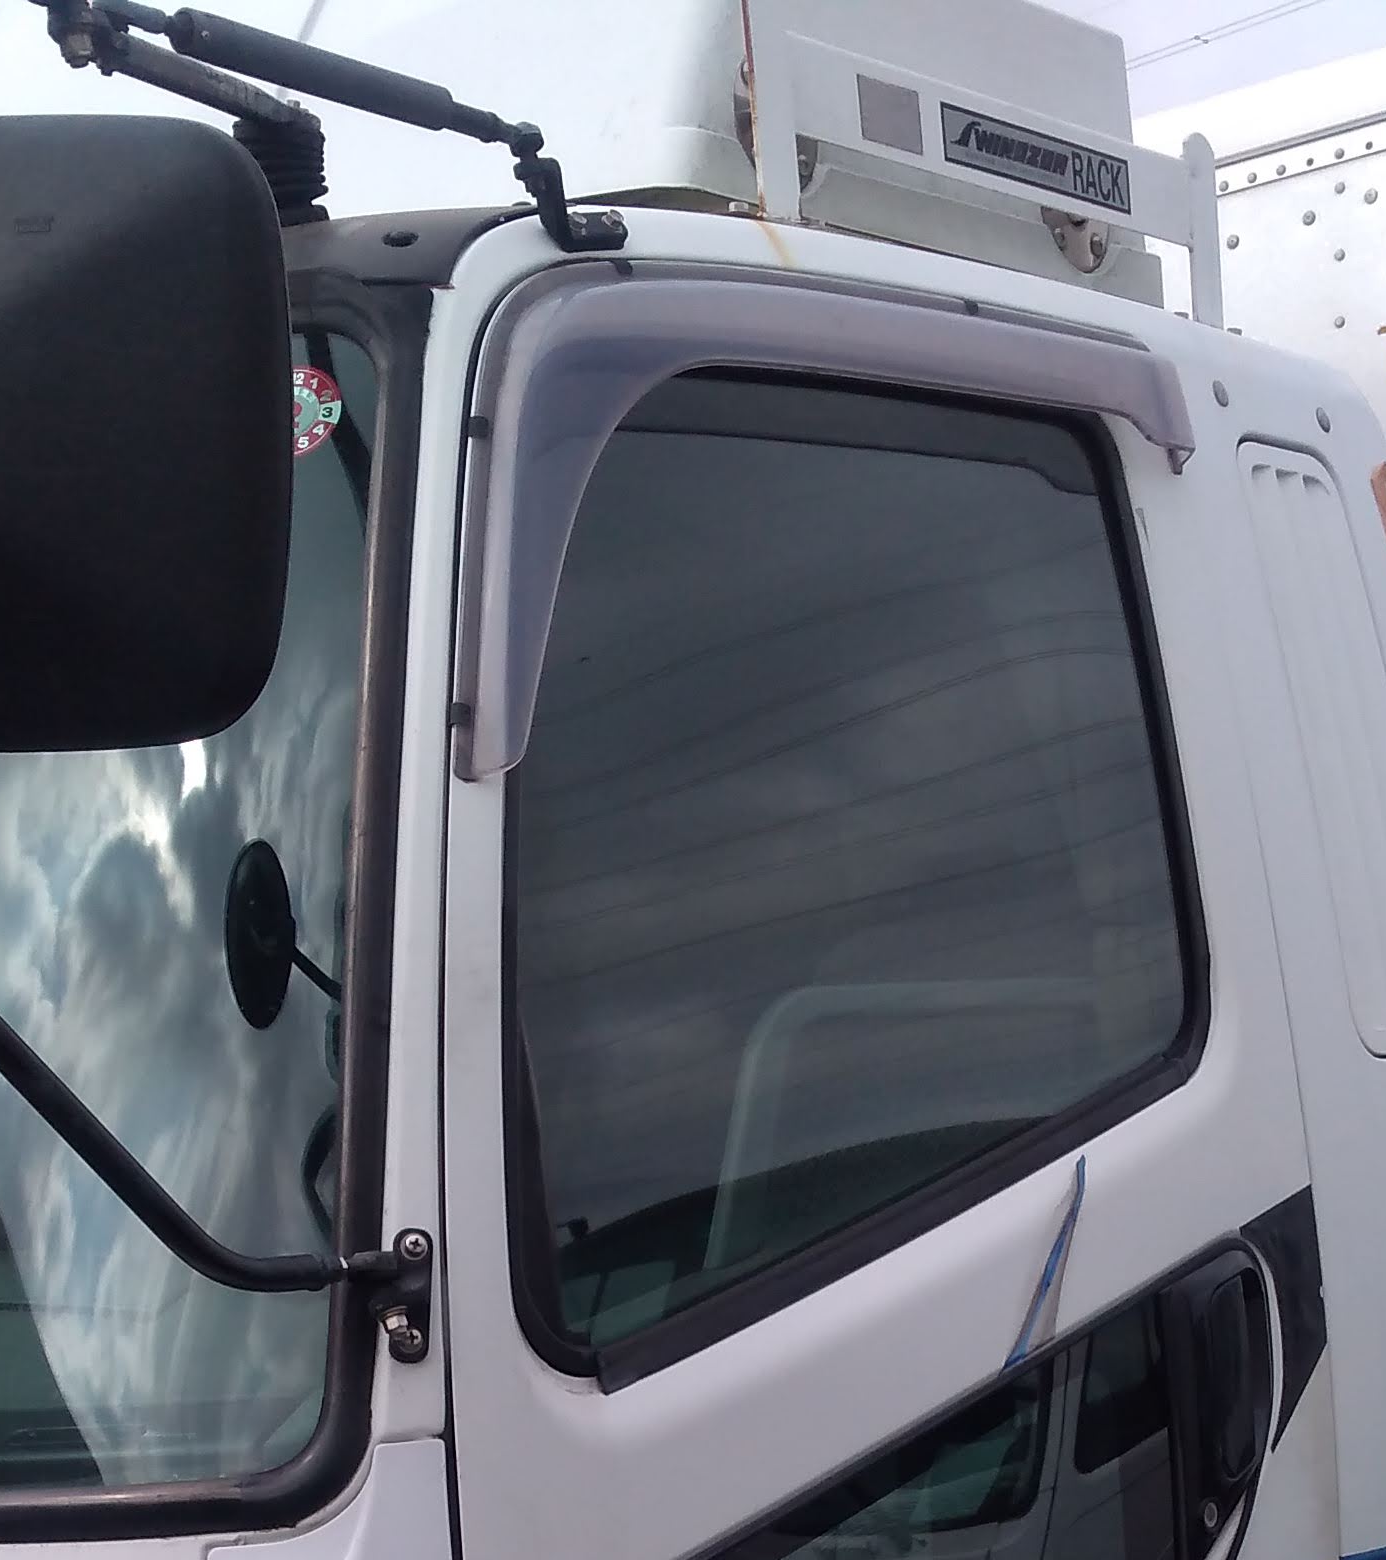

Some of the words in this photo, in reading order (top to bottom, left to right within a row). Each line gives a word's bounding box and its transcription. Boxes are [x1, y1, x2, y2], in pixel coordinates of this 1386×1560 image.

[1071, 150, 1125, 205] RACK
[321, 406, 333, 418] 3
[312, 423, 325, 436] 4
[297, 436, 309, 449] 5
